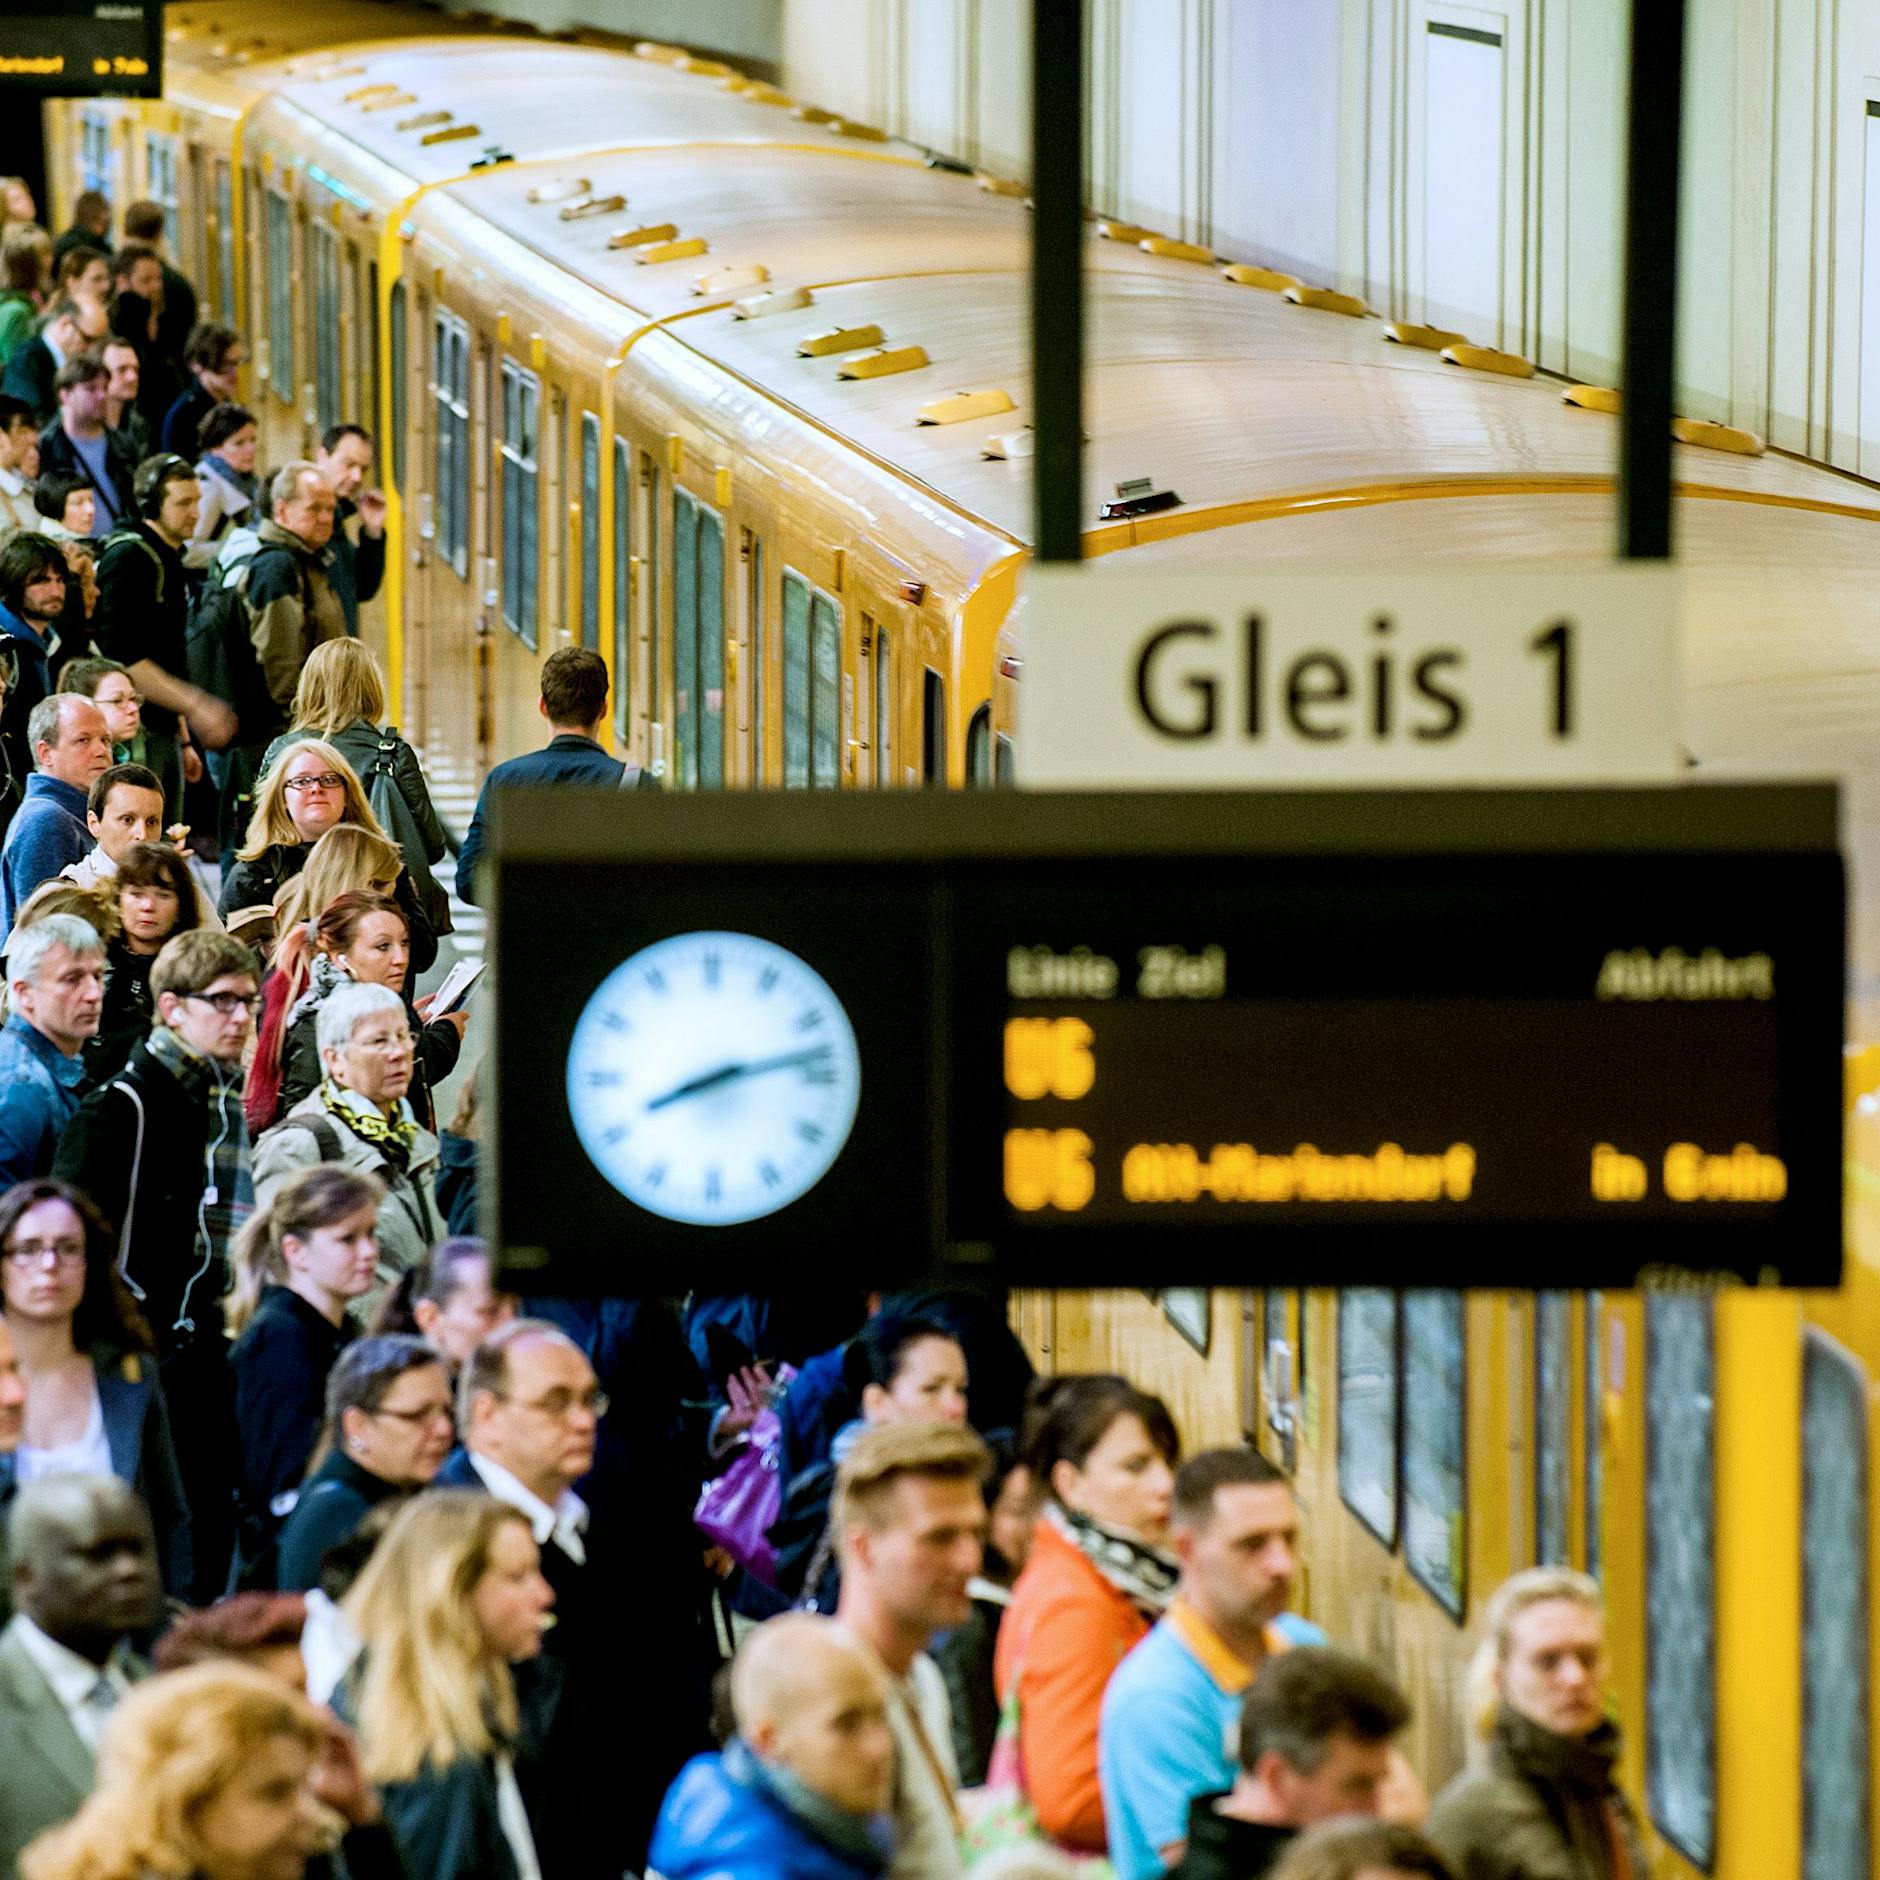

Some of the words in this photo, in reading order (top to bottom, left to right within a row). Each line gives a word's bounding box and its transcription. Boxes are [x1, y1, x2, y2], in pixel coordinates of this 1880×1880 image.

[1133, 616, 1467, 741] Gleis
[1532, 620, 1575, 740] 1
[1007, 948, 1117, 998] Linie
[1140, 946, 1225, 998] Ziel
